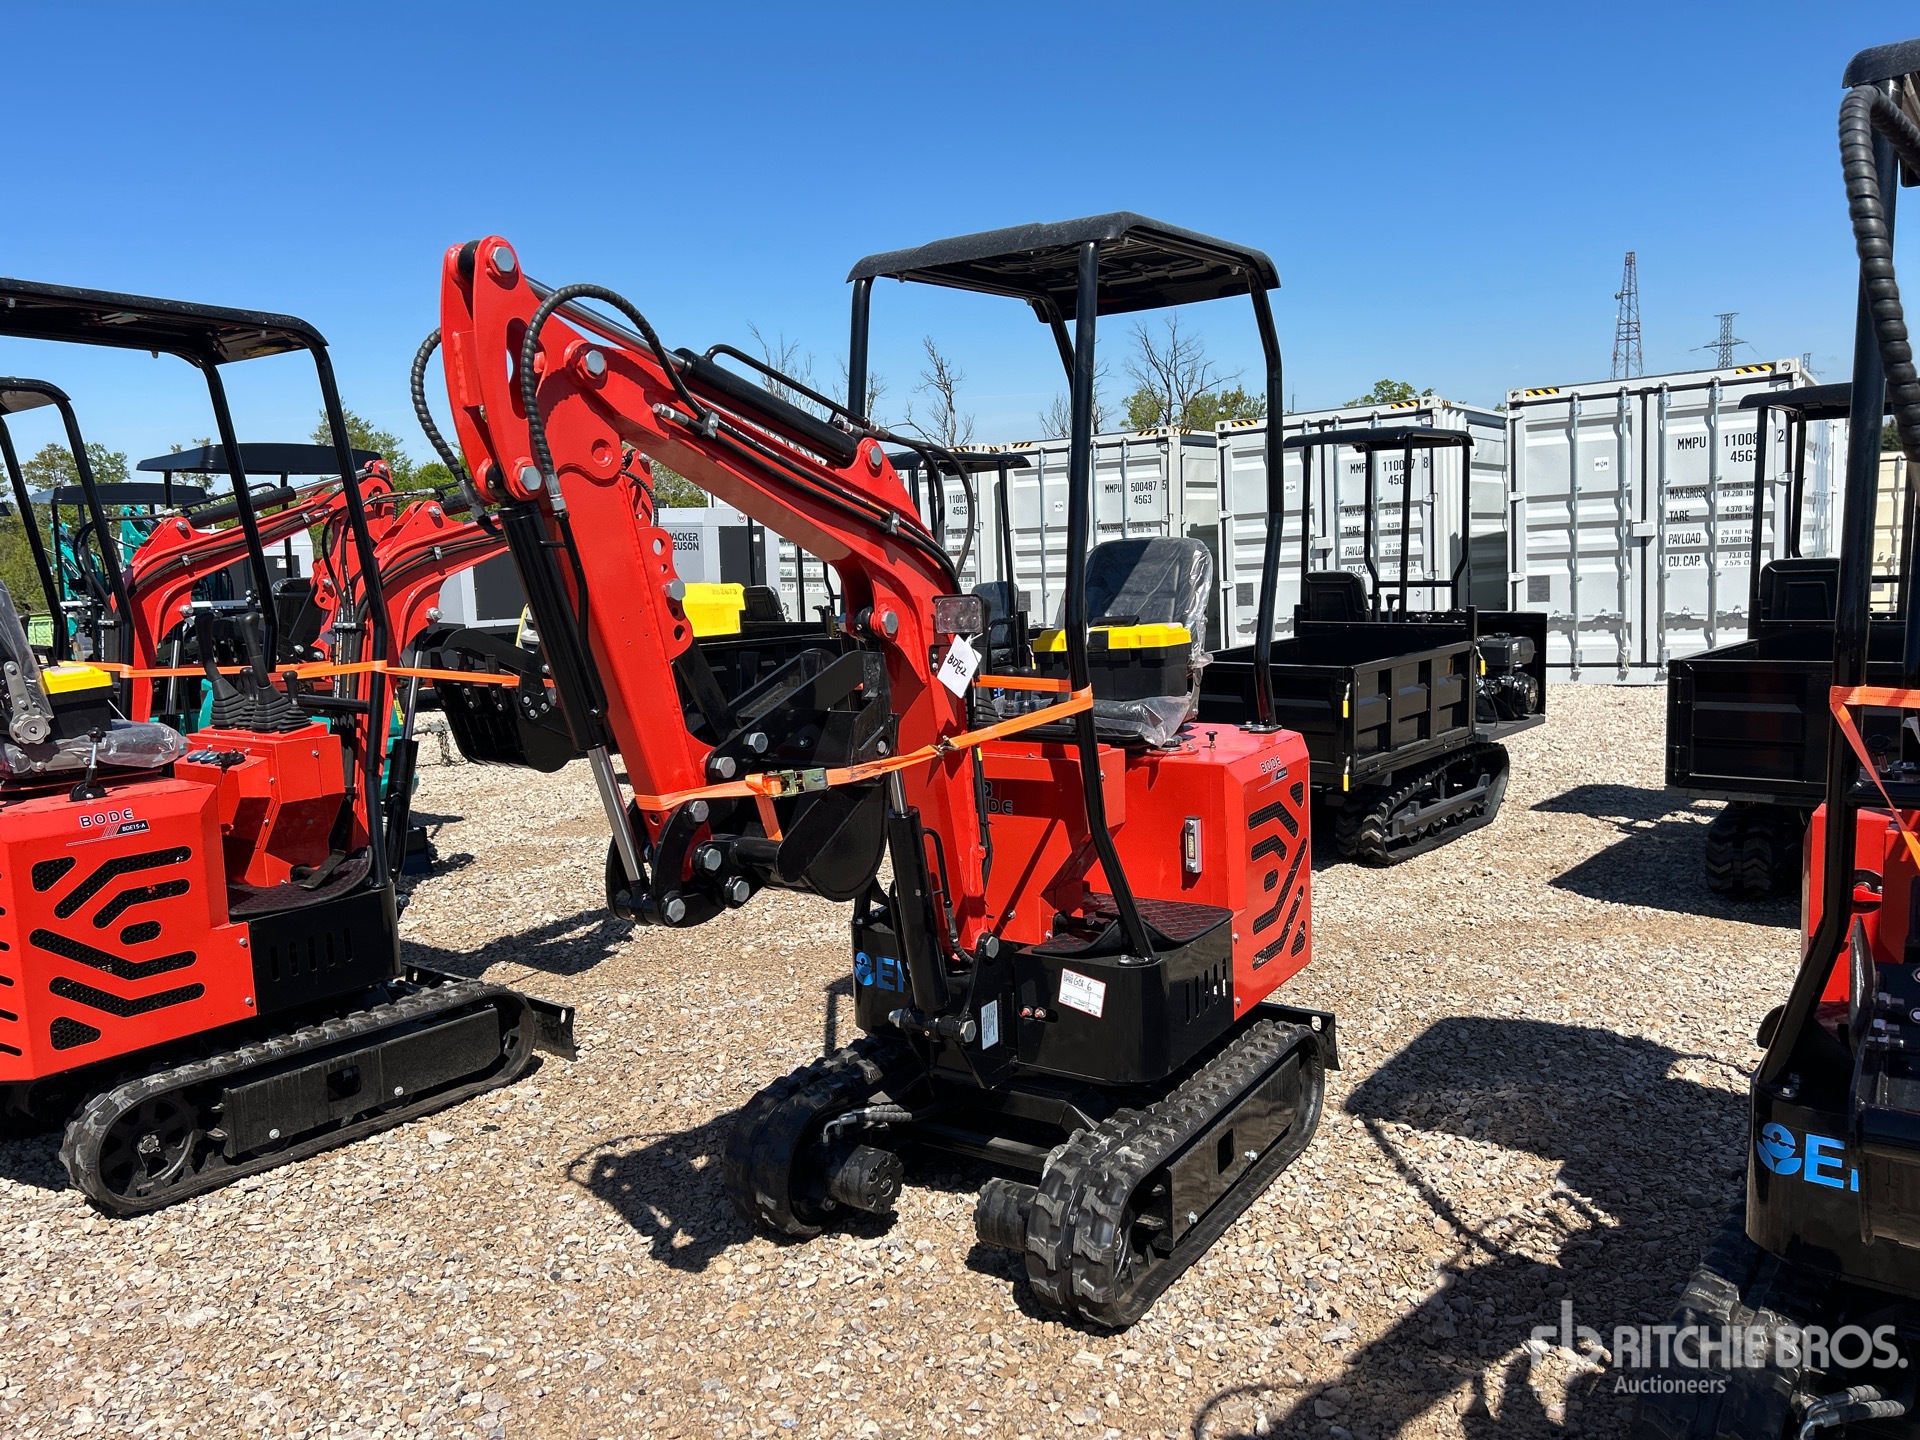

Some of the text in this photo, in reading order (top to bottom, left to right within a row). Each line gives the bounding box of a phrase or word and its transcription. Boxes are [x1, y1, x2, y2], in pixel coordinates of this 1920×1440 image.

[1677, 429, 1785, 450] MMPU 11008 2
[1350, 456, 1429, 475] MMP 11007 8
[1388, 474, 1405, 485] 45G
[1105, 480, 1167, 493] MMPU 500487 5
[1134, 494, 1152, 504] 45G3
[1669, 487, 1707, 500] MAX.GROSS
[1669, 510, 1690, 522] TARE
[1345, 526, 1361, 537] TARE
[1668, 532, 1701, 545] PAYLOAD
[672, 541, 700, 551] EUSON
[1345, 545, 1365, 557] PAYLO
[1683, 555, 1701, 566] CAP.
[1260, 755, 1282, 774] BODE
[79, 807, 134, 828] BODE
